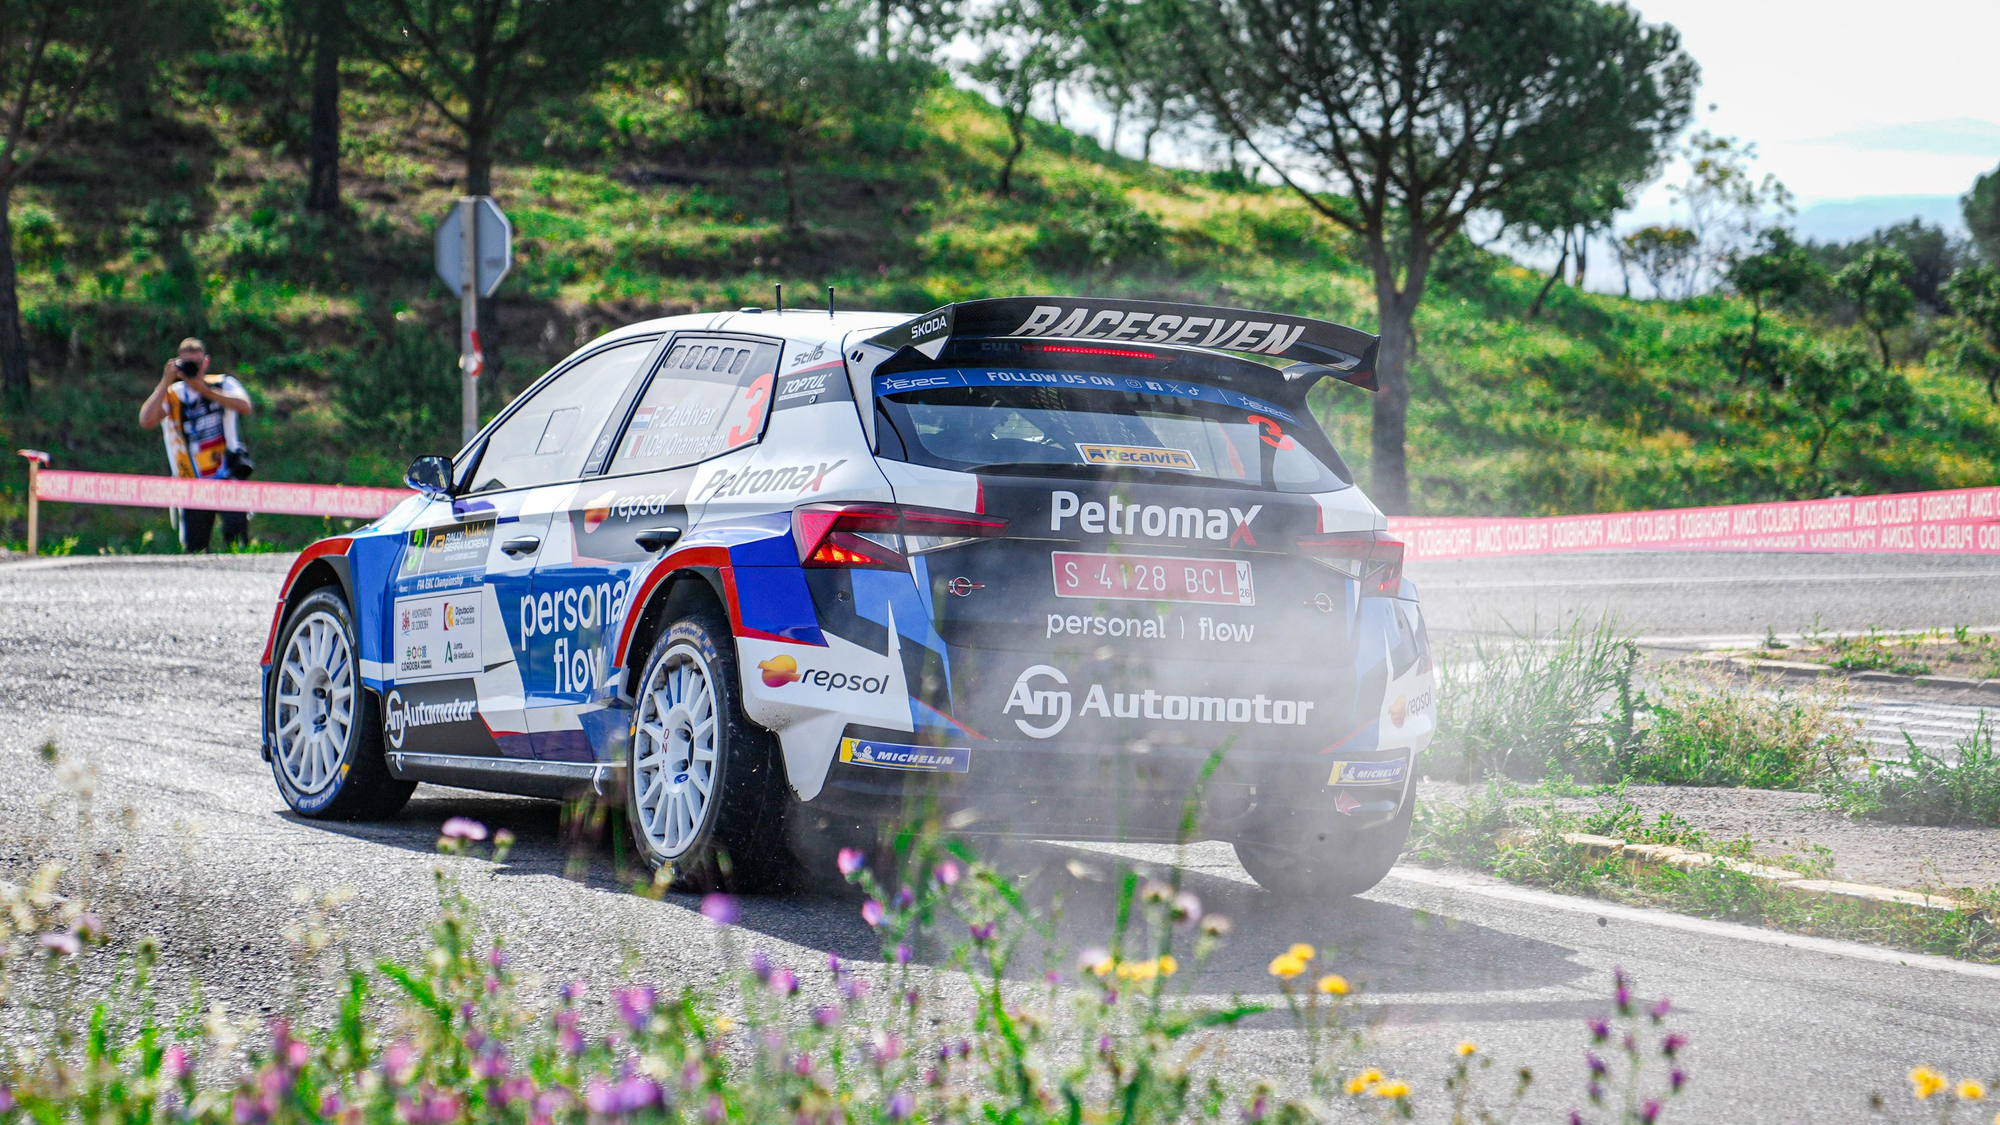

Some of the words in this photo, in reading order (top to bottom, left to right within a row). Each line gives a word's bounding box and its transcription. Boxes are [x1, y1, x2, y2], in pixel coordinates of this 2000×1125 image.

[1008, 305, 1306, 355] RACESEVEN
[782, 374, 826, 395] TOPTUL
[986, 371, 1057, 384] FOLLOW
[1061, 374, 1087, 384] US
[1089, 376, 1115, 387] ON
[728, 373, 774, 449] 3
[1247, 415, 1295, 451] 3
[1105, 449, 1171, 464] Recalvi
[695, 460, 848, 500] Petromax
[610, 489, 678, 522] repsol
[1051, 491, 1263, 548] Petromax
[407, 529, 423, 571] 3
[1065, 563, 1078, 587] S
[1100, 564, 1166, 591] 4128
[1185, 567, 1233, 595] BCL
[1238, 570, 1247, 582] V
[1240, 588, 1250, 598] 26
[1046, 614, 1166, 639] personal
[1199, 617, 1255, 643] flow
[801, 668, 890, 695] repsol
[403, 698, 477, 728] Automotor
[1079, 684, 1315, 726] Automotor
[1406, 686, 1432, 718] repsol
[876, 751, 955, 765] MICHELIN
[1357, 766, 1402, 779] MICHELIN
